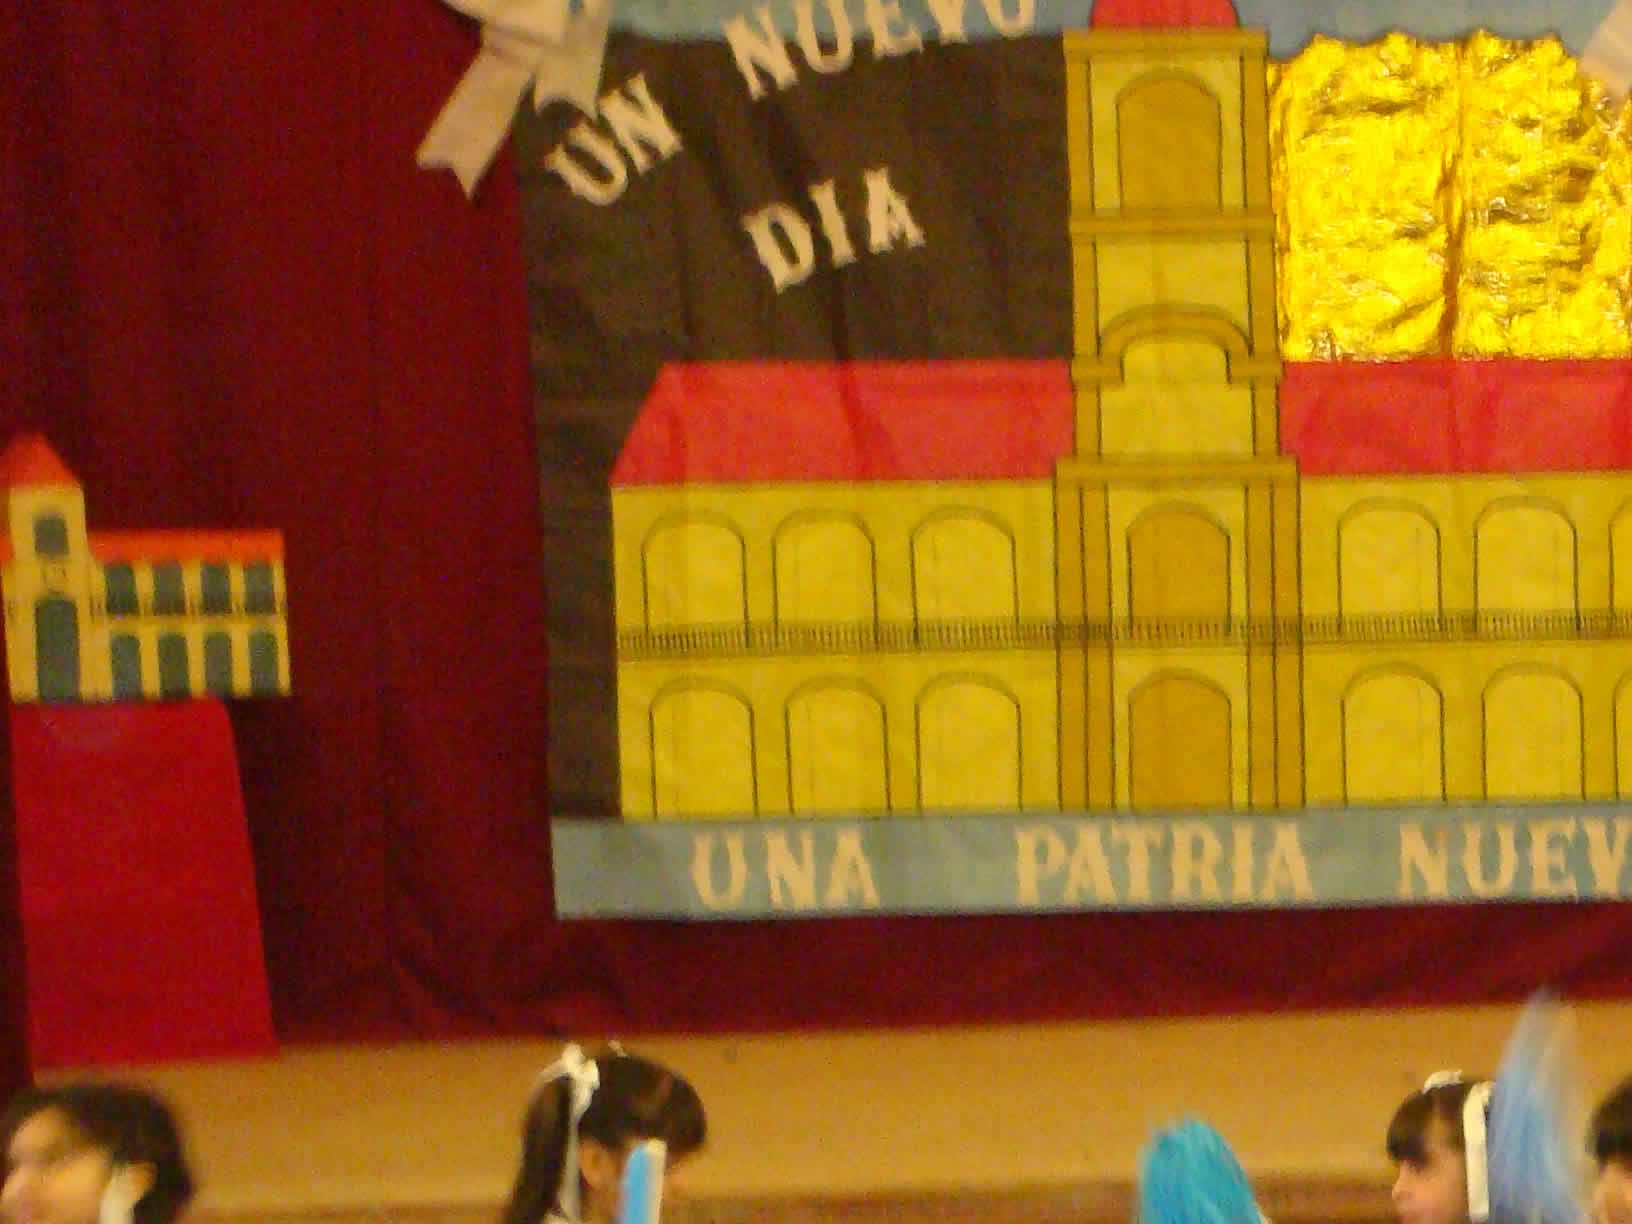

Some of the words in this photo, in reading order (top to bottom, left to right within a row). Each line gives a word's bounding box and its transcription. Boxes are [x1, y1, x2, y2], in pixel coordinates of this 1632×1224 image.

[543, 72, 682, 207] UN
[742, 165, 926, 294] DIA
[691, 827, 881, 911] UNA
[1013, 818, 1316, 906] PATRIA
